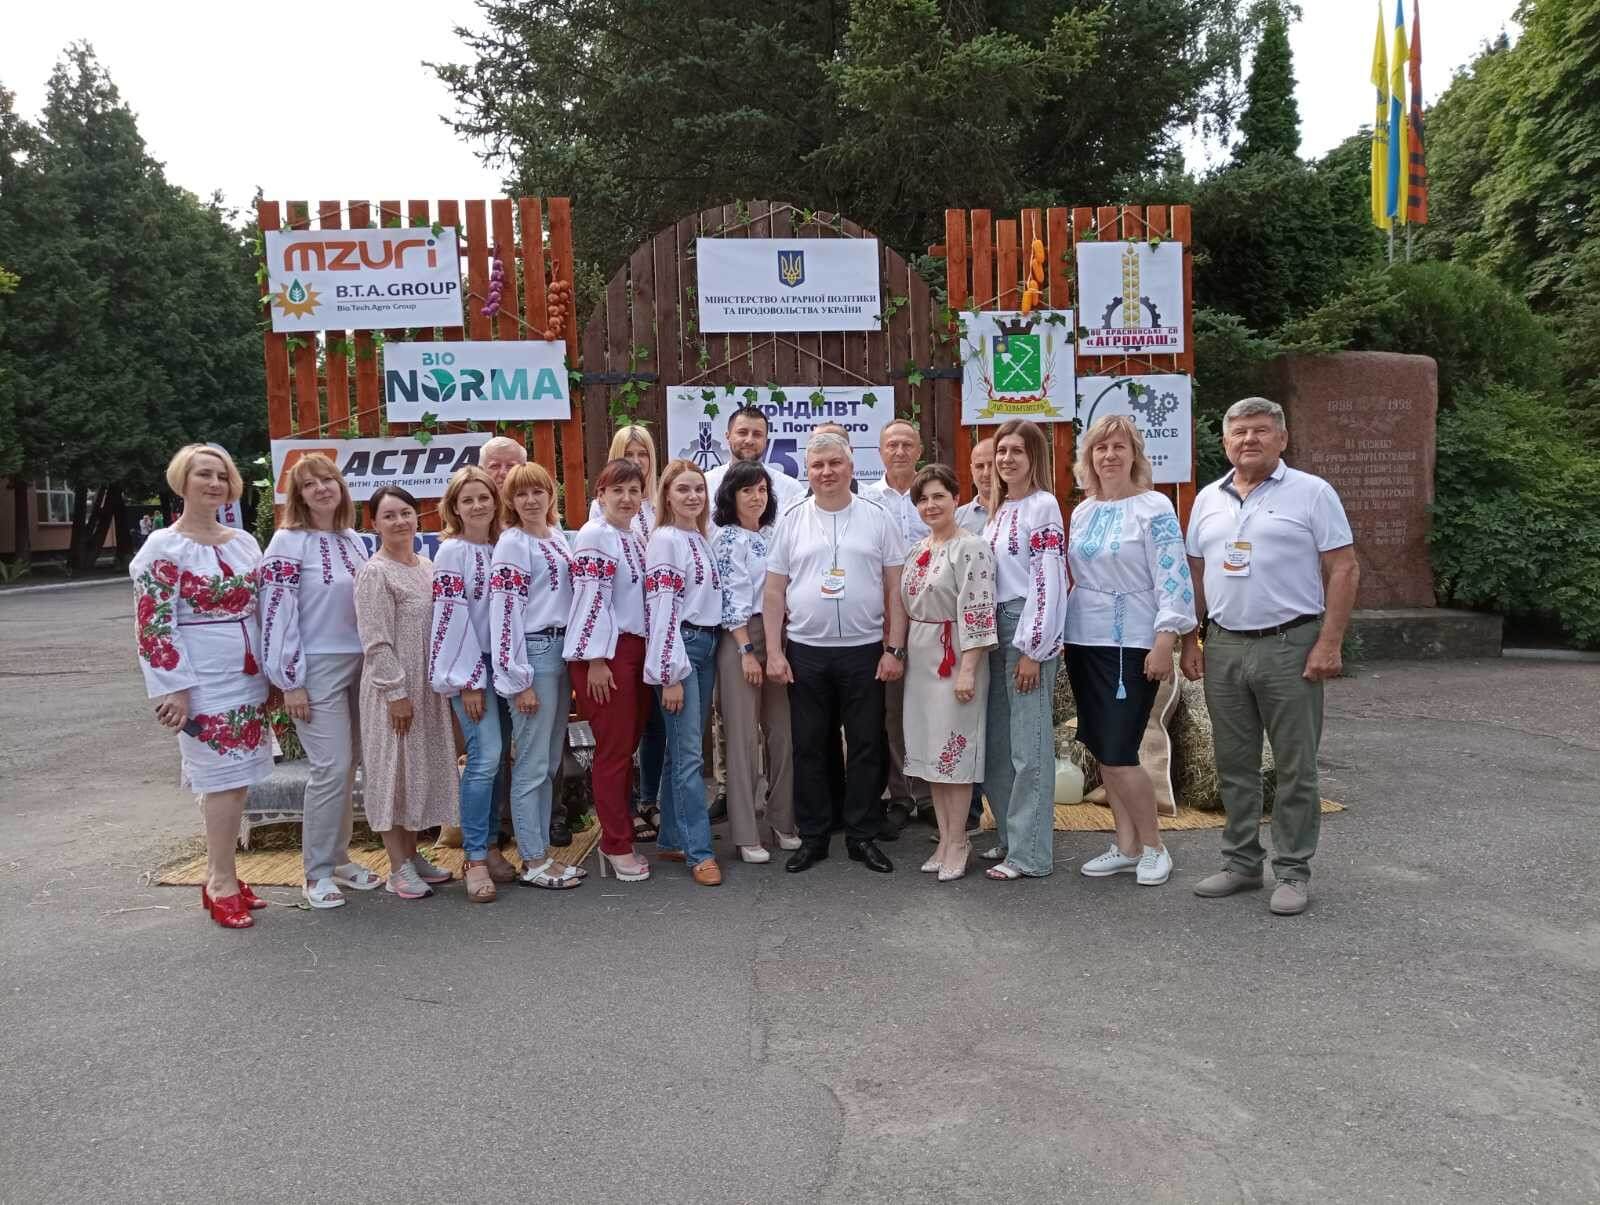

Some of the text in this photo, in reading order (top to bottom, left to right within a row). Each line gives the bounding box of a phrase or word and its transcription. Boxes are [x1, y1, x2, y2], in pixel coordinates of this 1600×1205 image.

[336, 282, 457, 298] B.T.A. GROUP
[704, 294, 876, 304] МІНІСТЕРСТВО АГРАРНОЇ ПОЛІТИКИ
[723, 305, 862, 315] ТА ПРОДОВОЛЬСТВА УКРАЇНИ
[422, 352, 455, 366] BIO
[386, 368, 563, 402] NORMA
[342, 446, 481, 476] АСТРА
